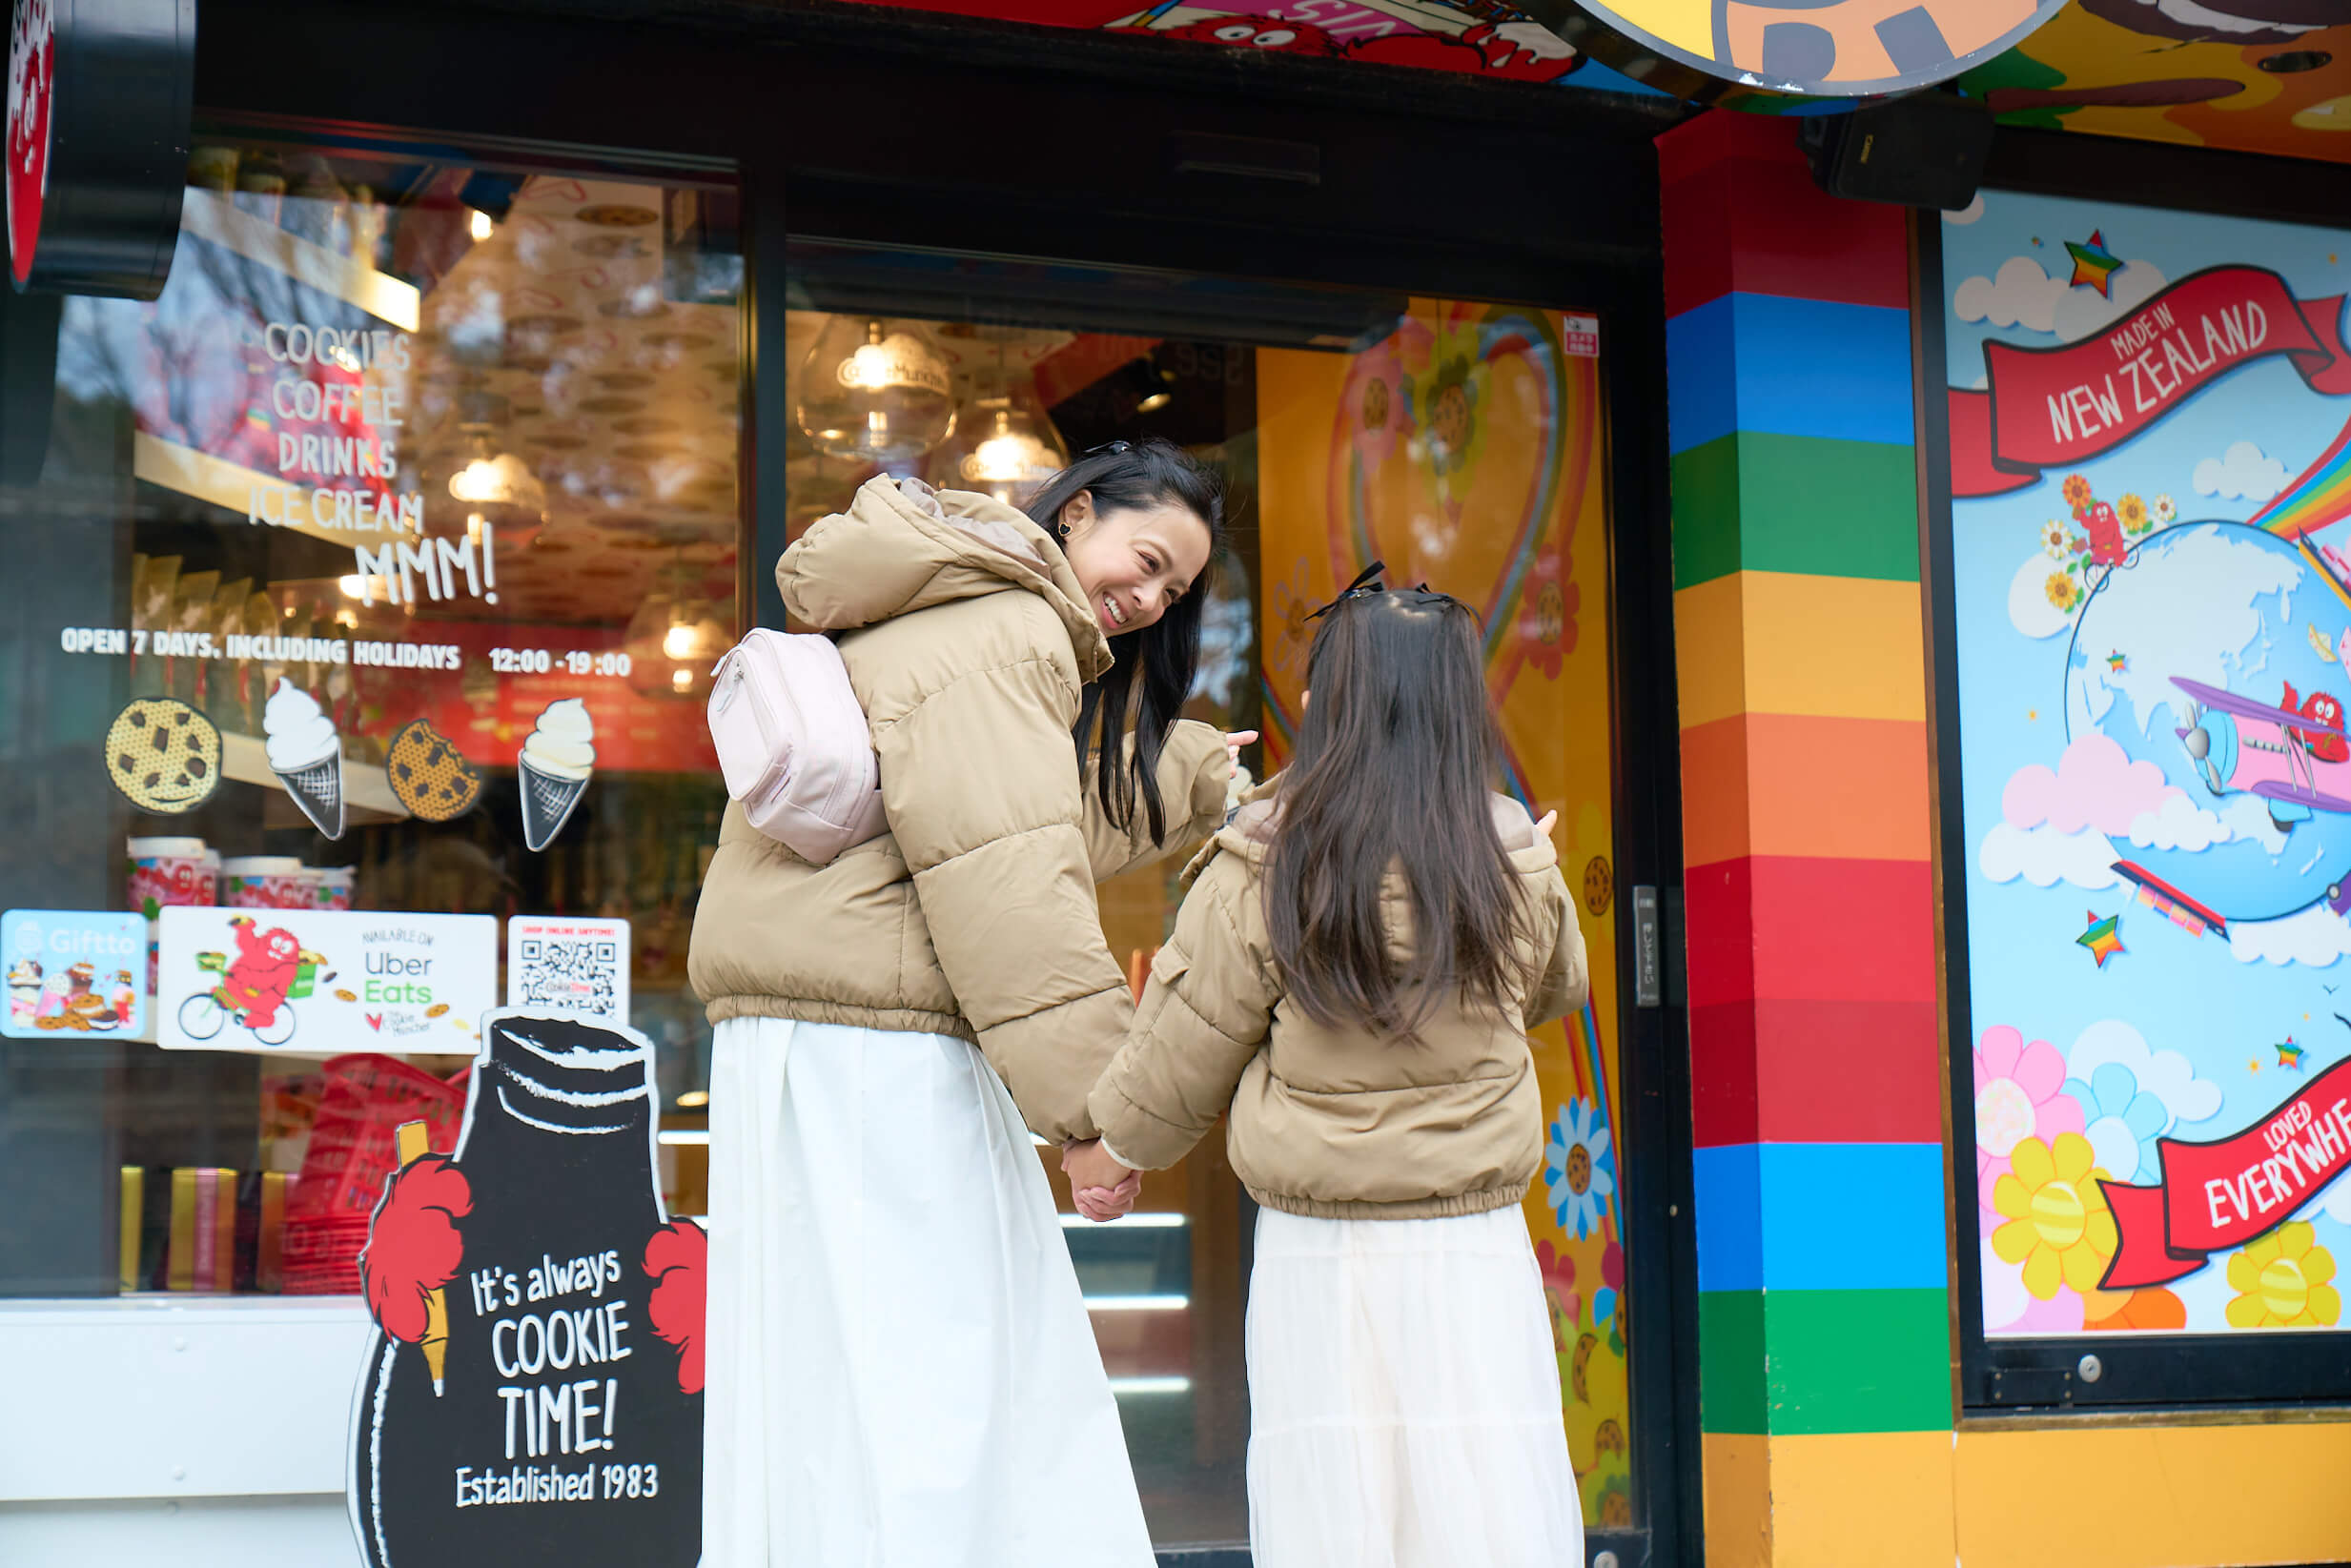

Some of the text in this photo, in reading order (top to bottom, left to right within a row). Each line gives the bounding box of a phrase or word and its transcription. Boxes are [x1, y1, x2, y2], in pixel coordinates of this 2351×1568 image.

[264, 322, 411, 372] COOKIES
[2110, 301, 2176, 360] MADE IN
[2047, 299, 2268, 443] NEW ZEALAND
[273, 379, 403, 427] COFFEE
[277, 431, 398, 478] DRINKS
[248, 485, 424, 534] ICE CREAM
[355, 520, 499, 608] MMM!
[61, 626, 127, 654] OPEN
[132, 630, 148, 654] 7
[226, 635, 348, 664] INCLUDING
[353, 641, 461, 670] HOLIDAYS
[488, 647, 550, 674] 12:00
[49, 928, 136, 955] Giftto
[362, 929, 434, 947] AVAILABLE ON
[365, 951, 433, 976] Uber
[365, 979, 432, 1004] Eats
[2263, 1100, 2312, 1152] LOVED
[470, 1249, 622, 1316] It's always
[491, 1299, 633, 1378] COOKIE
[497, 1378, 619, 1460] TIME!
[456, 1462, 659, 1508] Established 1983
